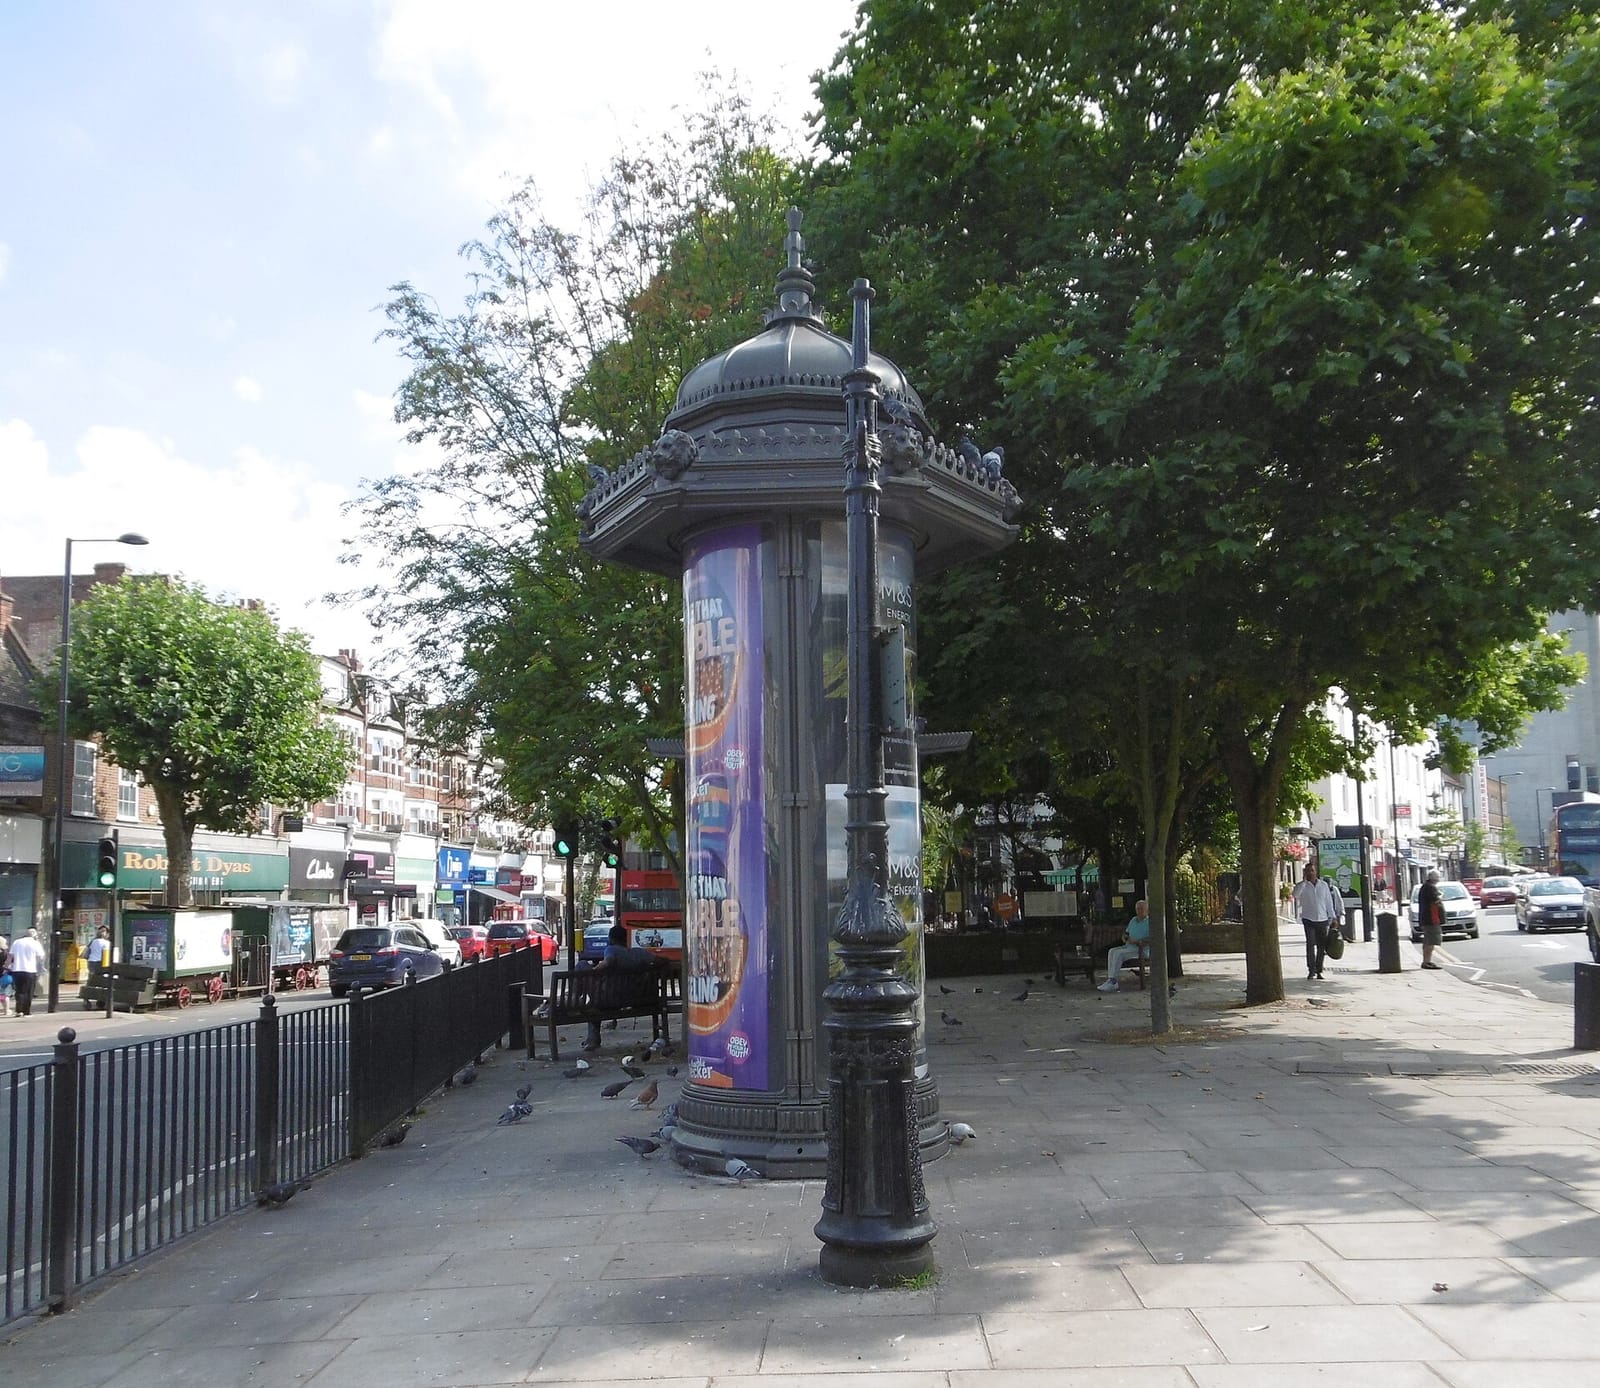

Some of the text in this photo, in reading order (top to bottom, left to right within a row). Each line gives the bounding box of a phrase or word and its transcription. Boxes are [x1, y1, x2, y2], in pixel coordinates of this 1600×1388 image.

[880, 580, 912, 607] M&S
[695, 598, 723, 622] THAT
[123, 851, 251, 875] Robt Dyas
[888, 856, 920, 878] M&S
[699, 875, 727, 899] THAT
[727, 1043, 749, 1058] MOUTH
[729, 1036, 747, 1046] OBEY
